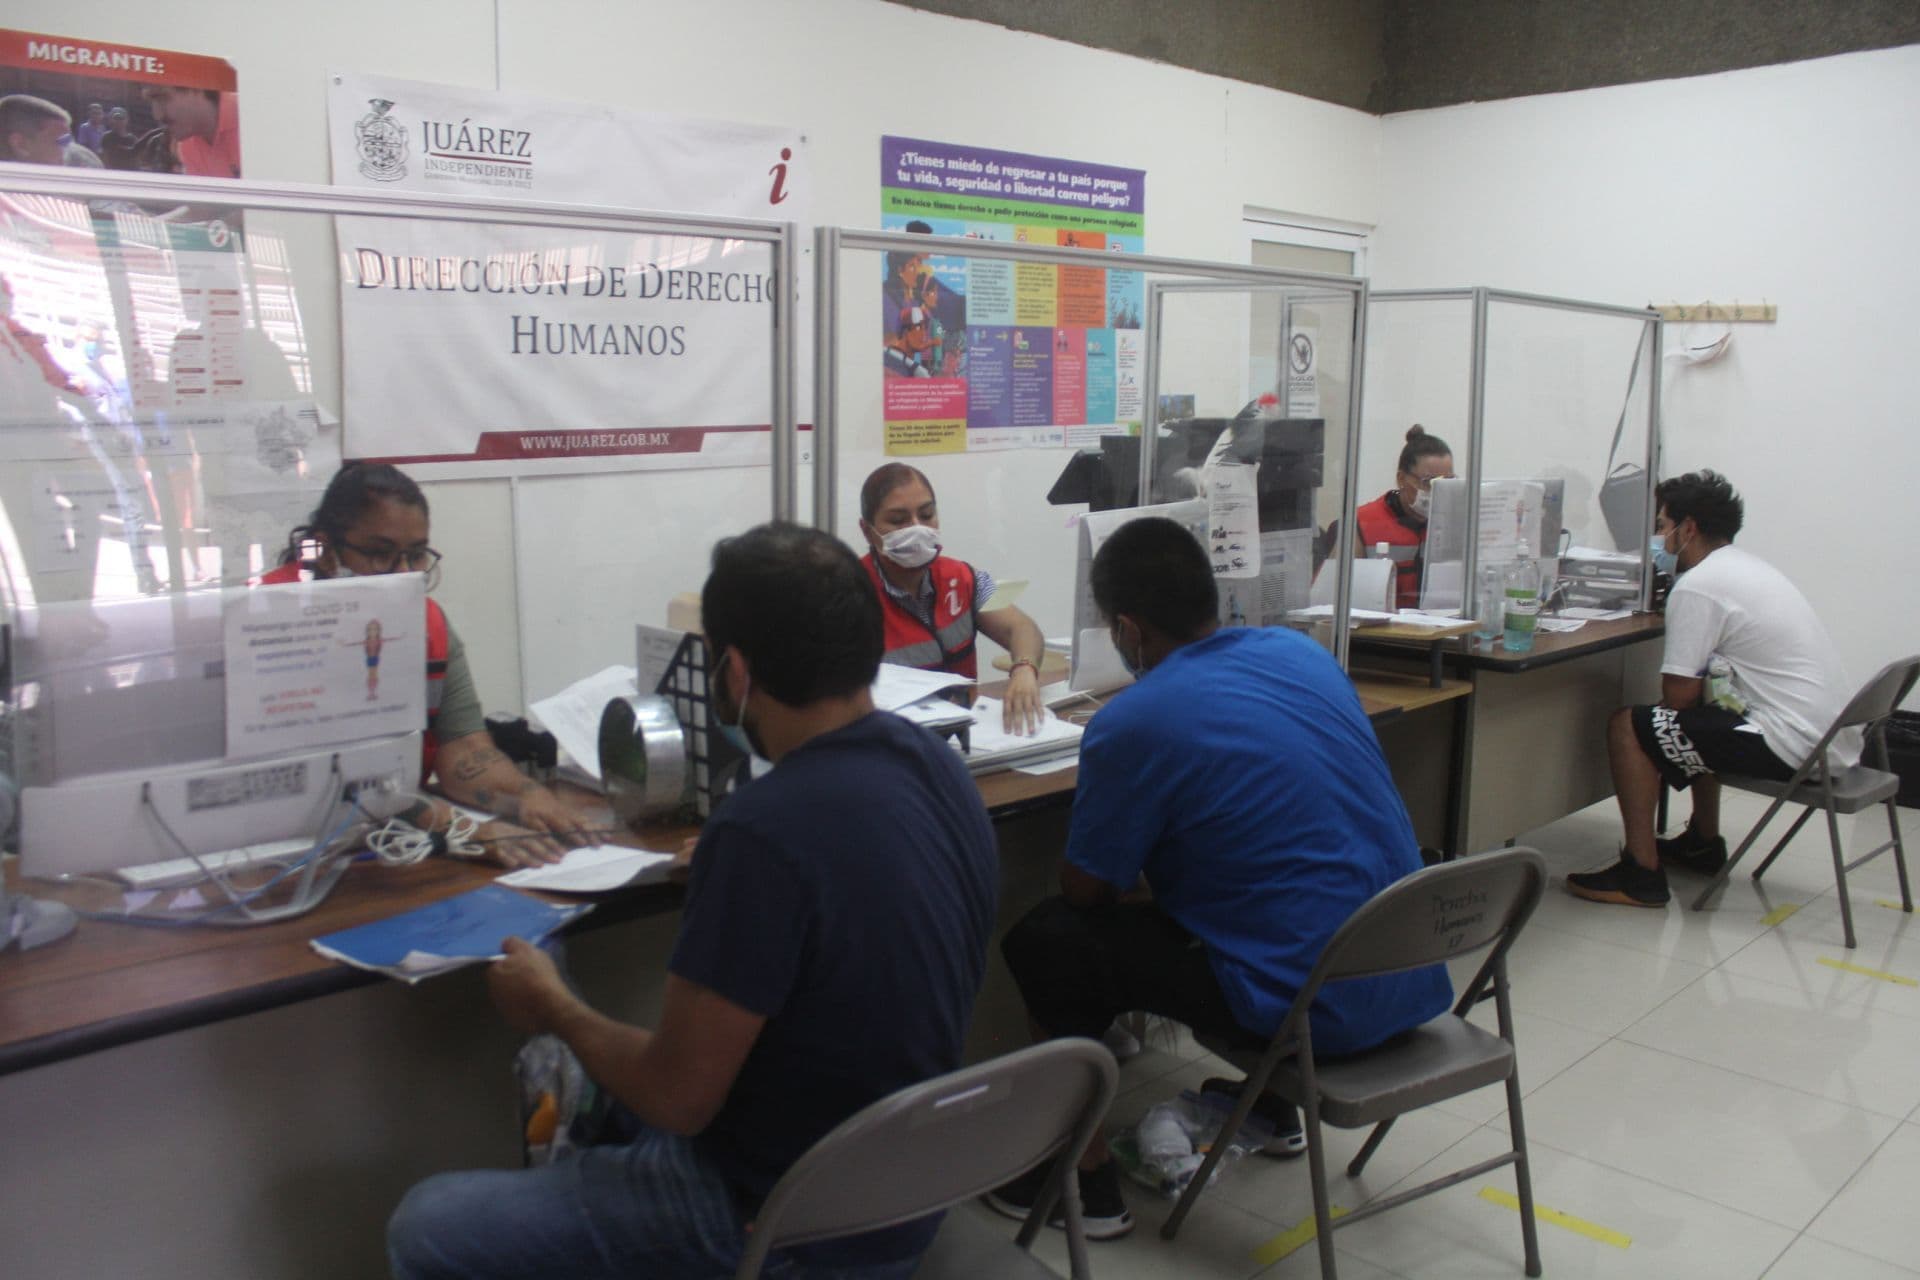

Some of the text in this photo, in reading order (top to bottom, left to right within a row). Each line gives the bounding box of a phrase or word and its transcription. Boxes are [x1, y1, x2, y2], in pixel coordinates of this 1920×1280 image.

[28, 41, 165, 74] MIGRANTE:
[422, 118, 532, 157] JUÁREZ
[424, 158, 534, 180] INDEPENDIENTE
[768, 148, 791, 204] i
[897, 169, 1130, 208] tu vida, seguridad o libertad corren peligro?
[900, 152, 945, 168] ¿Tienes
[947, 158, 983, 173] miedo
[985, 161, 999, 174] de
[1002, 165, 1046, 181] regresar
[1048, 172, 1055, 181] a
[1058, 171, 1069, 183] tu
[1093, 178, 1128, 192] porque
[356, 247, 799, 304] DIRECCIÓN DE DERECH
[511, 314, 685, 357] HUMANOS
[520, 432, 670, 451] WWW.JUAREZ.GOB.MX
[944, 578, 962, 616] i
